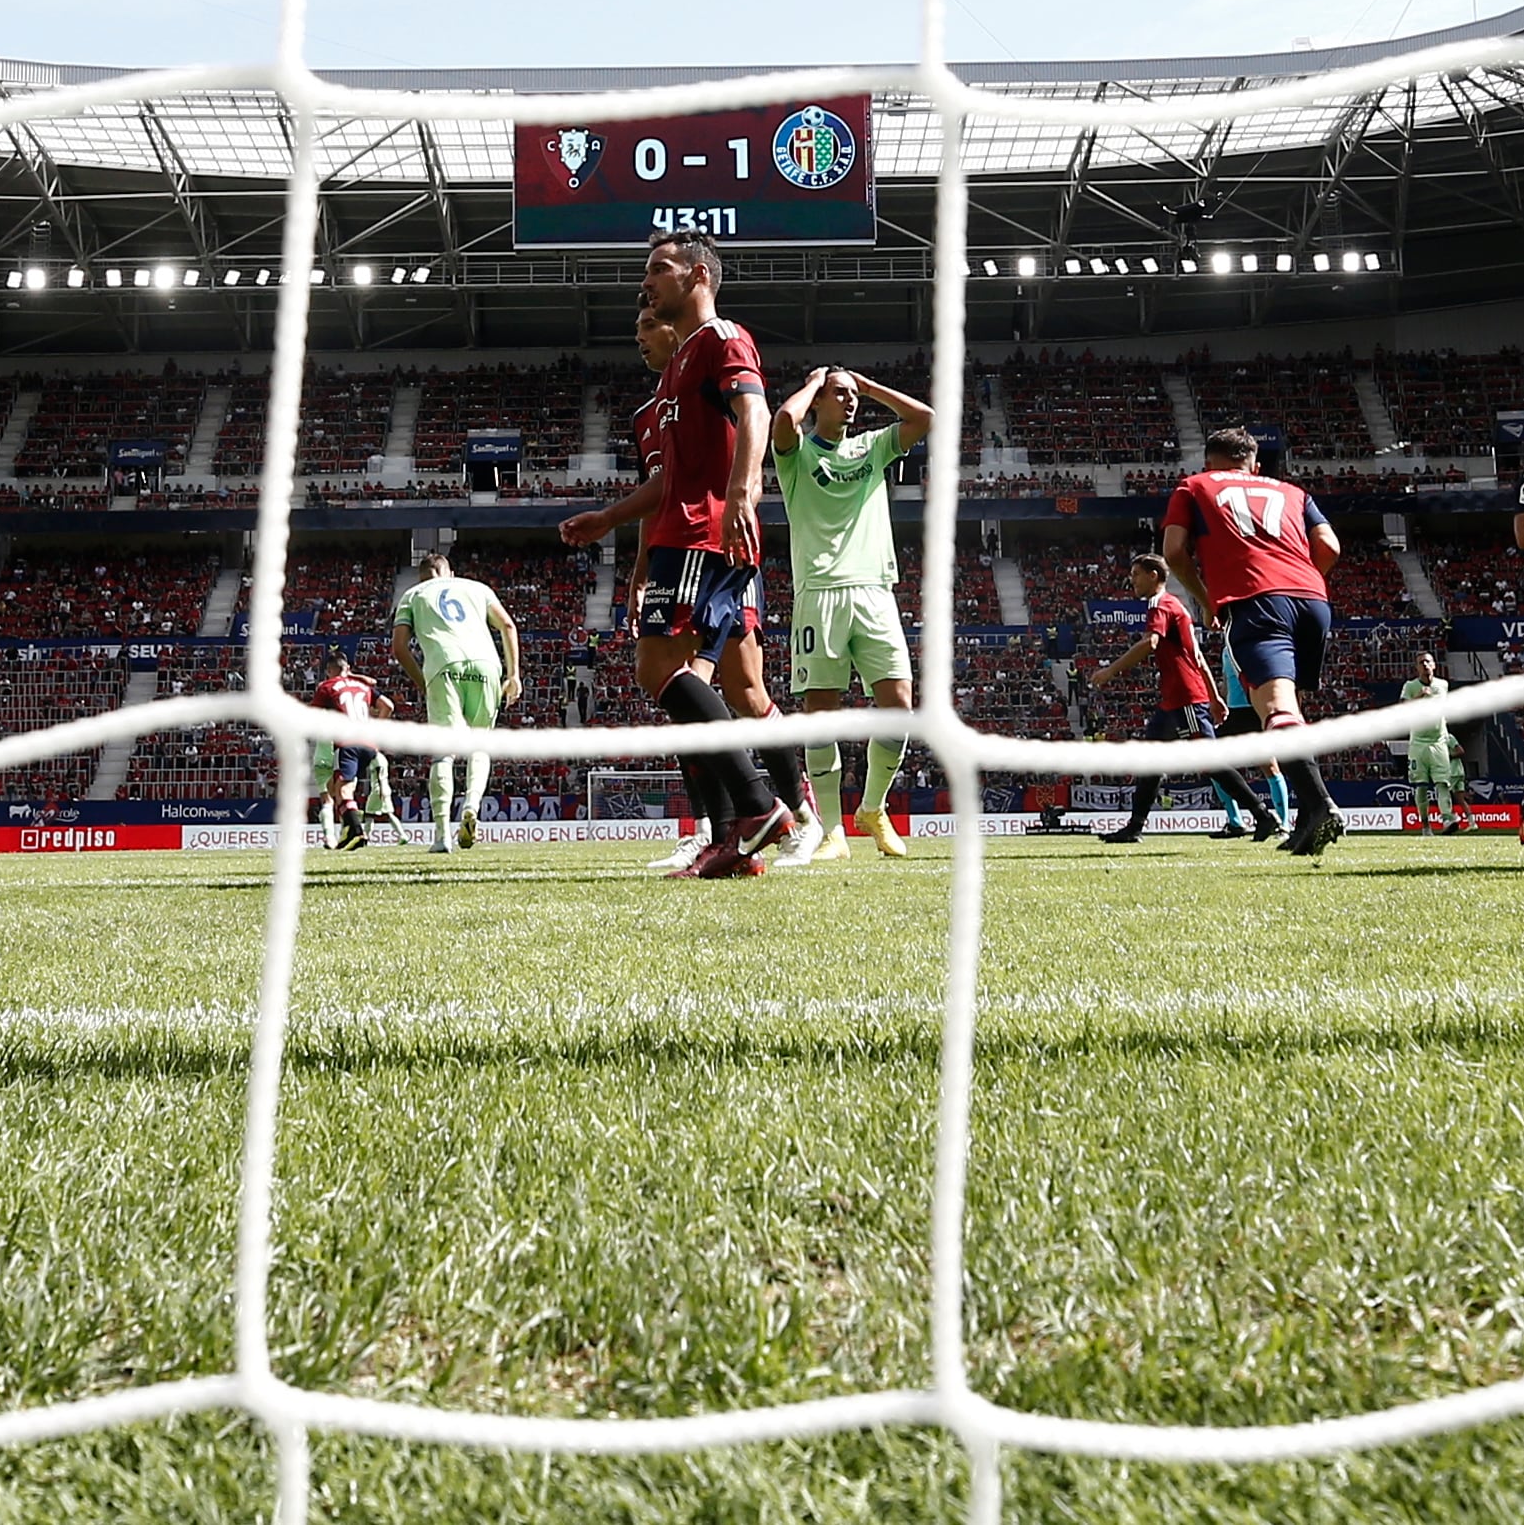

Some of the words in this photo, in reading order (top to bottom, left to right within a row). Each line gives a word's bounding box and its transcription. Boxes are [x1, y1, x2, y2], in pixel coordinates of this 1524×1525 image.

[634, 138, 667, 181] 0
[728, 138, 750, 179] 1
[652, 207, 737, 235] 43:11
[1215, 486, 1285, 538] 17
[437, 588, 467, 623] 6
[795, 626, 815, 655] 10
[40, 829, 115, 852] redpiso
[190, 830, 268, 849] ¿QUIERES
[549, 827, 570, 842] EN
[576, 825, 671, 841] EXCLUSIVA?
